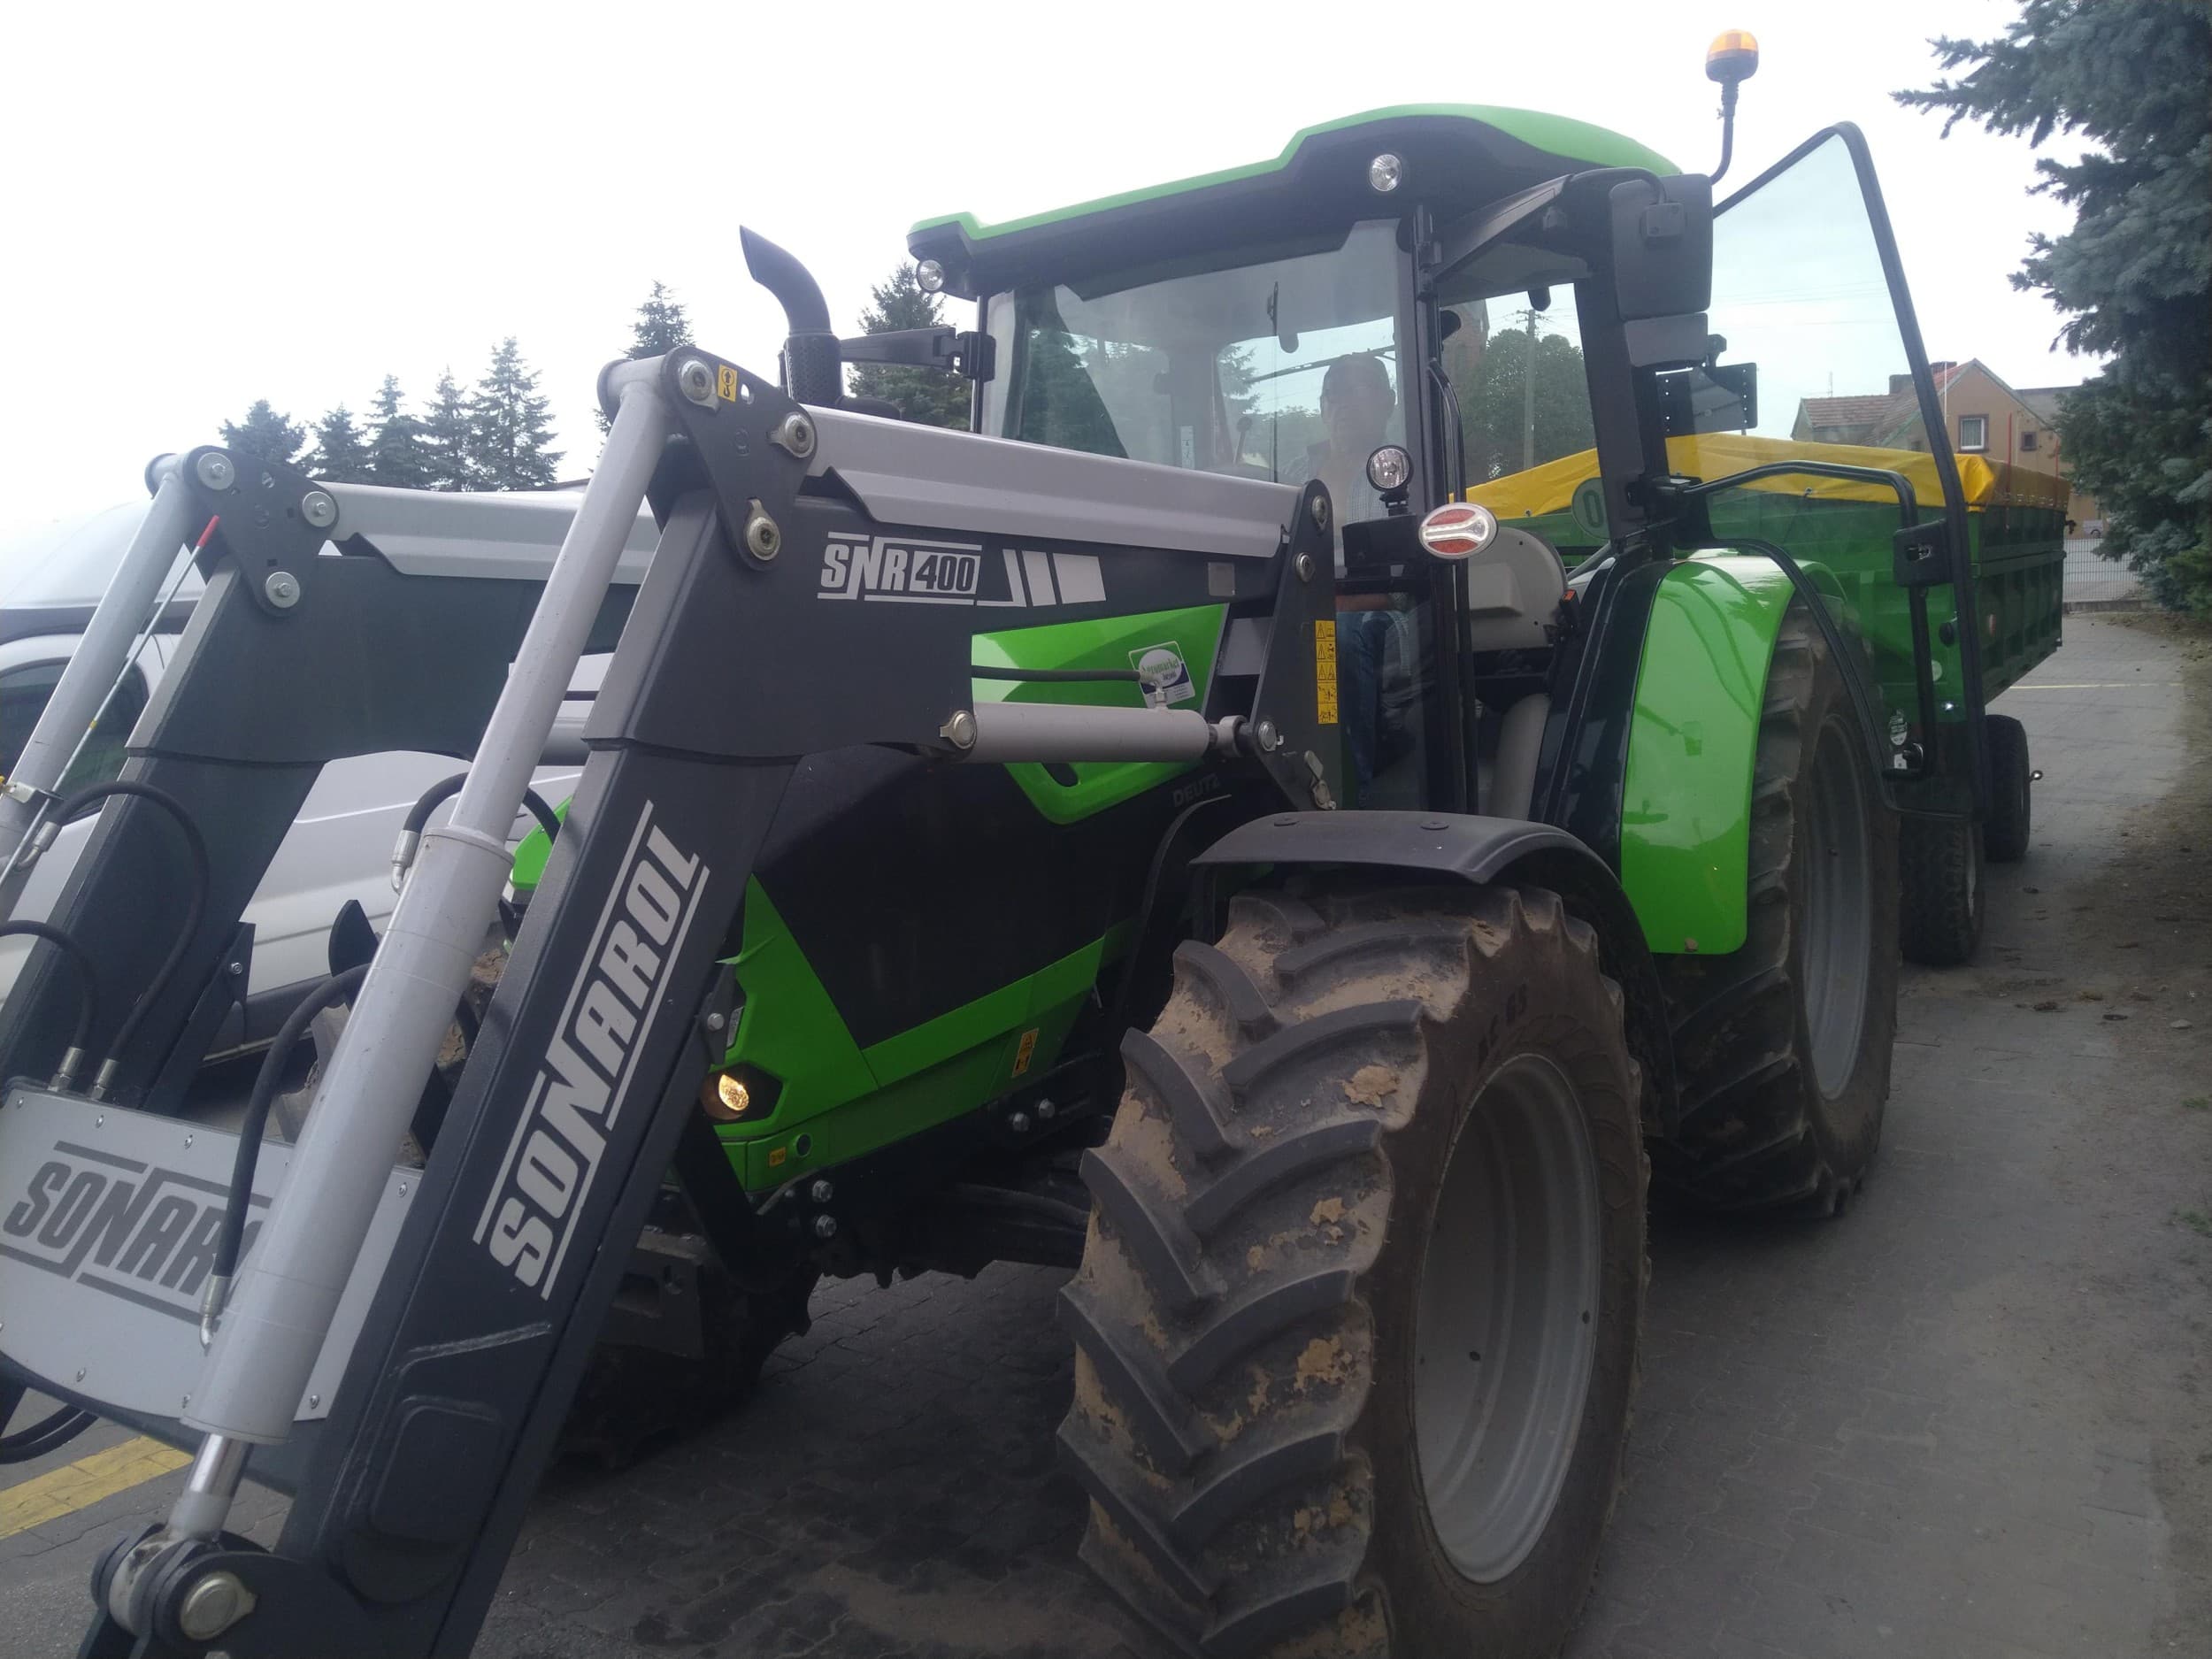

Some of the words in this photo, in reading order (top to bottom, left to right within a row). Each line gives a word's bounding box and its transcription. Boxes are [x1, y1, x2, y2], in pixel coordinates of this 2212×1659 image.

[820, 536, 910, 600] SNR
[914, 555, 977, 592] 400
[488, 823, 700, 1288] SONAROL
